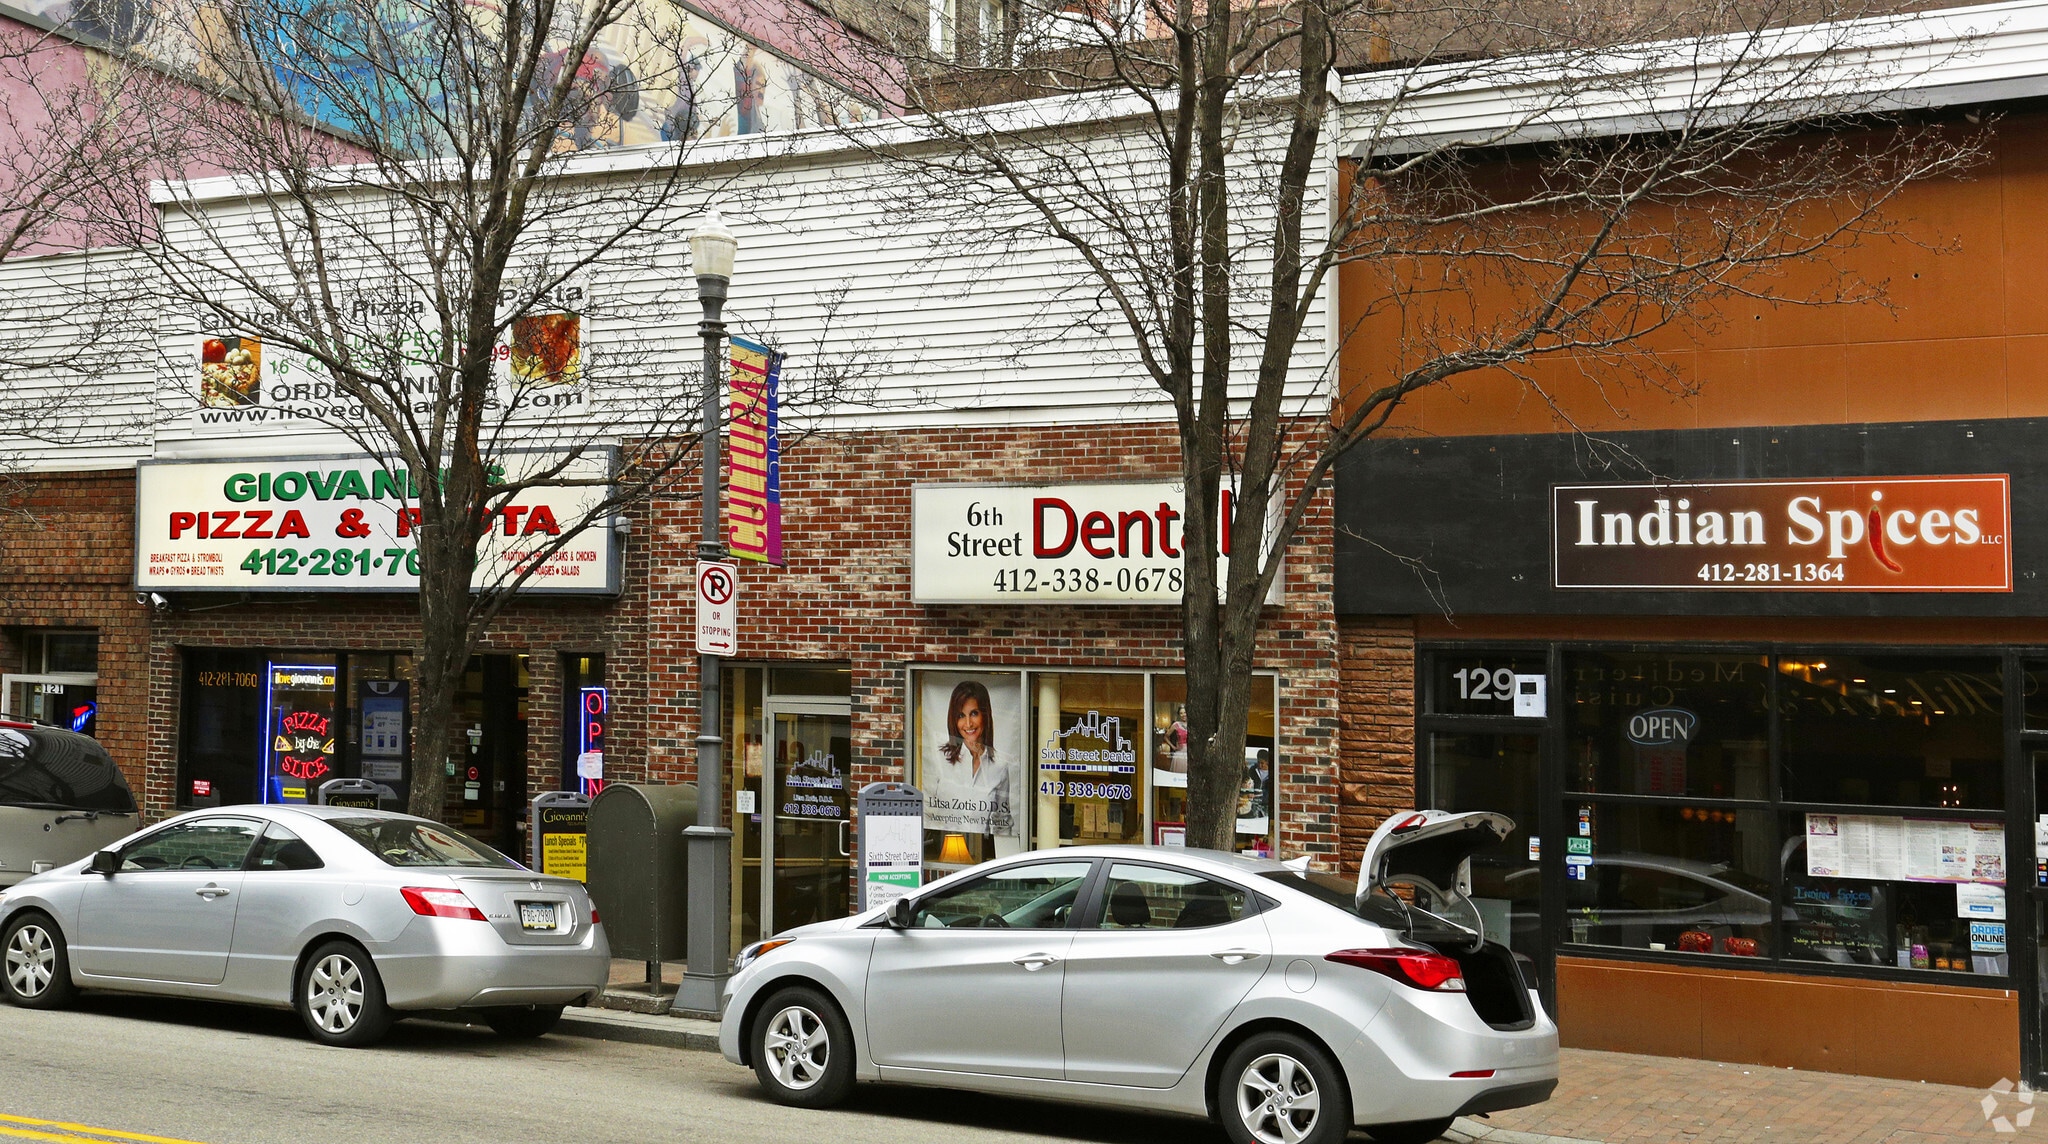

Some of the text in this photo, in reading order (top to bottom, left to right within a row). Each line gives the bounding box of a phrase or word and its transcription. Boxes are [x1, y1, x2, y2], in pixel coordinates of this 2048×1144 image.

[729, 358, 769, 554] CULTURAL
[169, 508, 311, 540] PIZZA
[335, 508, 372, 539] &
[967, 489, 1235, 560] 6th Dentl
[1574, 490, 2003, 574] Indian Spices LLC
[947, 531, 1023, 558] Street
[177, 553, 191, 563] PIZZA
[576, 551, 597, 562] CHICKEN
[149, 566, 224, 576] WRAPS GYROS BREAD TWISTS
[561, 566, 580, 576] SALADS
[1697, 563, 1845, 583] 412-281-1364
[993, 567, 1183, 593] 412-338-0678
[712, 611, 721, 621] OR
[701, 625, 731, 637] STOPPING
[45, 684, 62, 694] 121
[1453, 668, 1517, 701] 129
[283, 711, 330, 737] PIZZA
[1629, 714, 1690, 741] OPEN
[295, 736, 320, 754] by the
[1041, 747, 1136, 763] Sixth Street Dental
[282, 755, 329, 780] SLICE
[786, 774, 842, 785] Sixth Street Dental
[1040, 781, 1132, 800] 412 338-0678
[784, 803, 841, 817] 412 338-0678
[929, 796, 1011, 814] Litsa Zotis D.D.S.
[543, 807, 588, 823] Giovanni's
[931, 813, 1010, 827] Accepting New Patients
[545, 836, 558, 846] Lunch
[558, 835, 577, 847] Specials
[868, 851, 920, 861] Sixth Street Dental
[1971, 925, 2004, 935] ORDER
[1971, 933, 2004, 943] ONLINE
